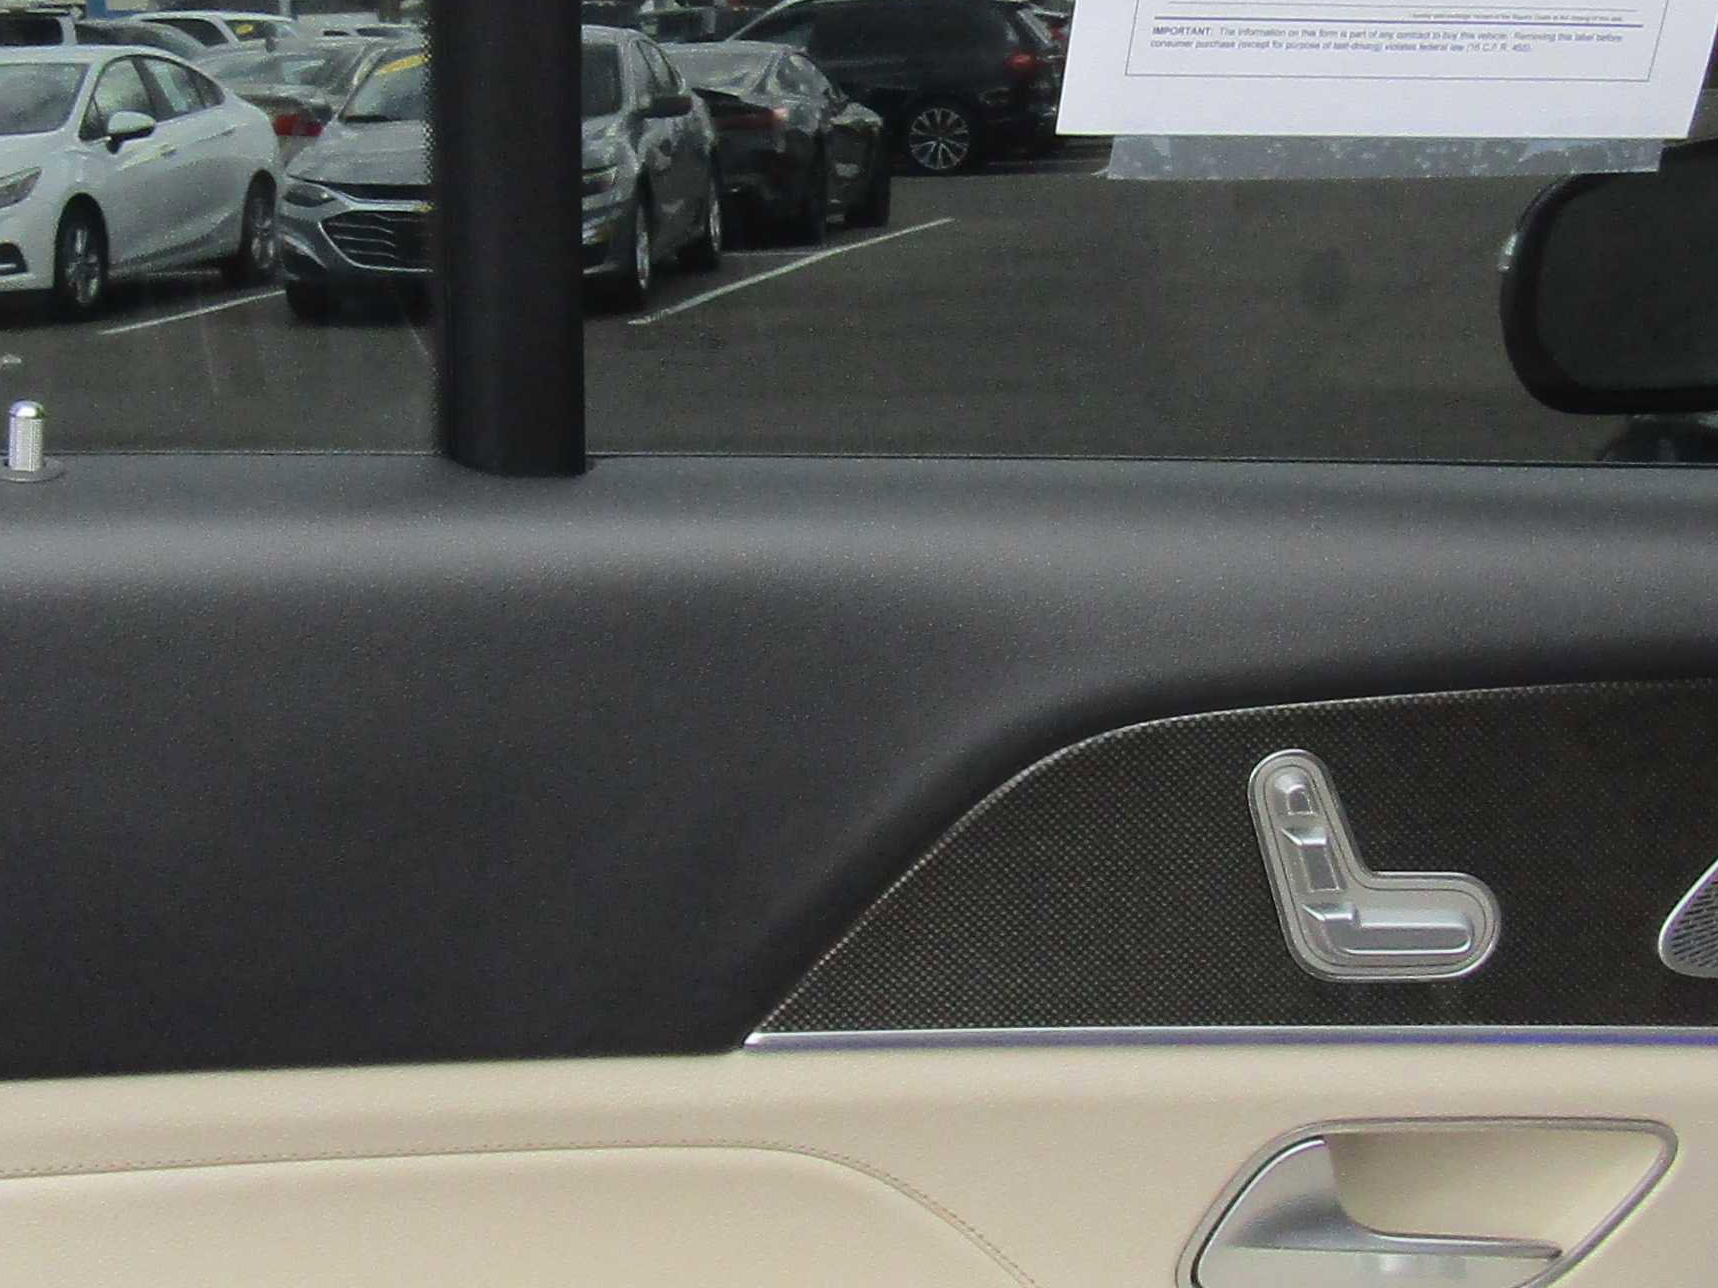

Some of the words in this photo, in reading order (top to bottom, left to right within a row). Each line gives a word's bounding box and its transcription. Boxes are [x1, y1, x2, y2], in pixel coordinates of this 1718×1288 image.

[1218, 27, 1235, 36] The
[1237, 27, 1285, 36] information
[1287, 28, 1299, 37] on
[1300, 28, 1316, 37] this
[1318, 29, 1338, 37] form
[1339, 29, 1347, 37] is
[1349, 29, 1367, 38] part
[1368, 30, 1379, 38] of
[1378, 30, 1395, 38] any
[1431, 31, 1441, 39] to
[1441, 31, 1457, 39] buy
[1458, 31, 1476, 40] this
[1512, 32, 1556, 41] Removing
[1556, 33, 1573, 41] this
[1574, 33, 1593, 42] label
[1595, 33, 1623, 42] before
